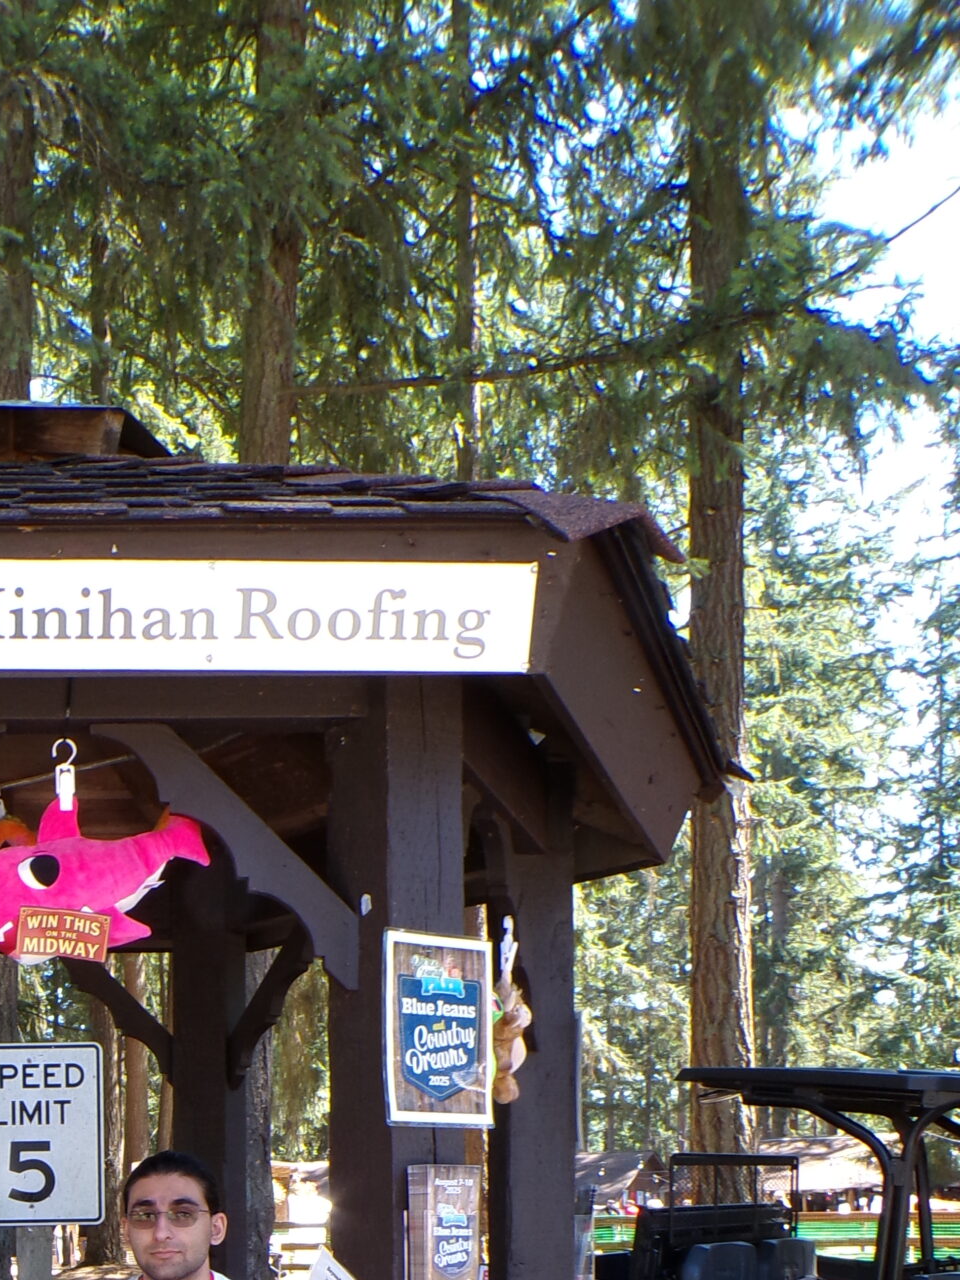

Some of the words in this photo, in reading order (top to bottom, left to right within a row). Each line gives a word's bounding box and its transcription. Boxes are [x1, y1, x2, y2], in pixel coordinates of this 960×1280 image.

[234, 587, 491, 659] Roofing
[27, 914, 59, 929] WIN
[63, 915, 101, 936] THIS
[61, 931, 78, 940] THE
[22, 937, 100, 959] MIDWAY
[401, 998, 435, 1016] Blue
[435, 1000, 476, 1018] Jeans
[414, 1021, 476, 1051] Country
[405, 1046, 468, 1075] Dreams
[428, 1075, 450, 1086] 2025
[8, 1140, 56, 1203] 5
